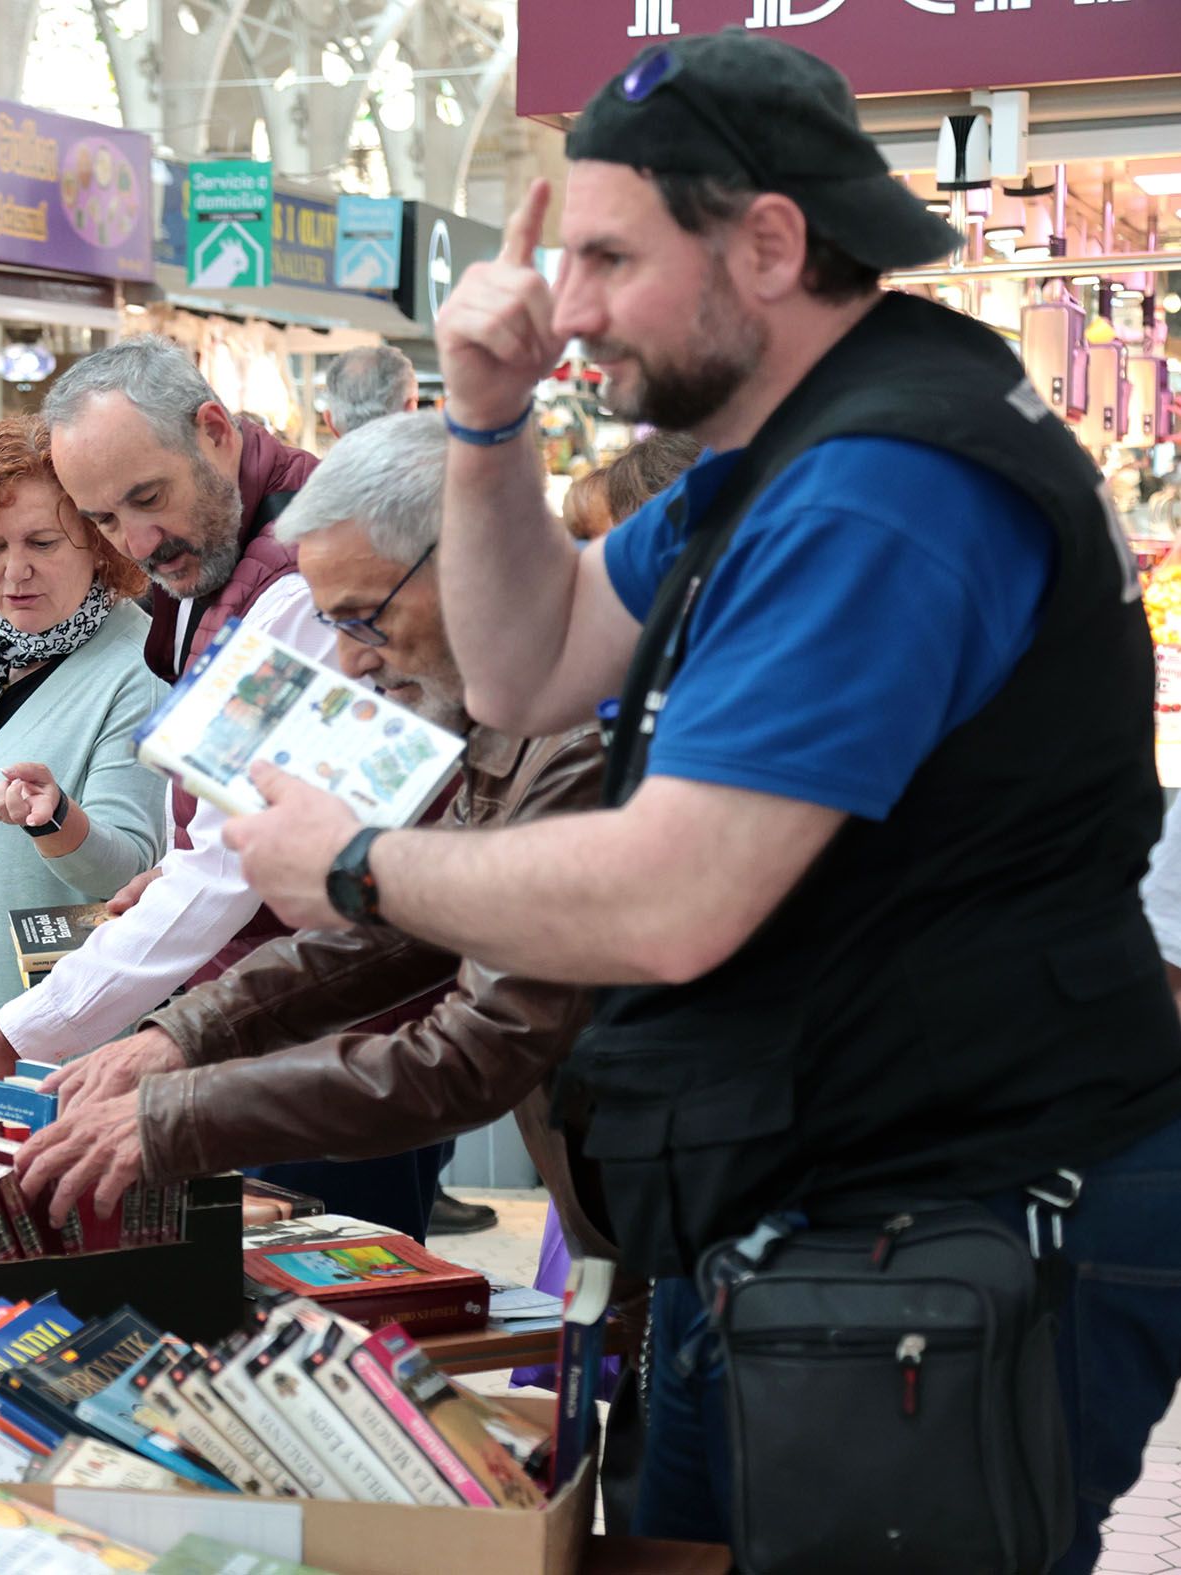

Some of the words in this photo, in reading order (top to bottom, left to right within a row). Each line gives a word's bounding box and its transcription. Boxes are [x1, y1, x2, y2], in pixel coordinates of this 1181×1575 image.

[192, 172, 251, 190] Servicio
[194, 193, 266, 210] domicilio
[34, 914, 52, 926] del
[39, 924, 58, 936] ojo
[53, 916, 72, 938] faraón
[42, 935, 57, 944] El
[40, 1331, 154, 1405] DUBROVNIK
[185, 1422, 243, 1478] MADRID
[222, 1418, 264, 1462] RIOJA
[256, 1412, 326, 1491] CATALUNYA
[358, 1407, 414, 1471] MANCHA
[407, 1417, 468, 1489] Andalucía
